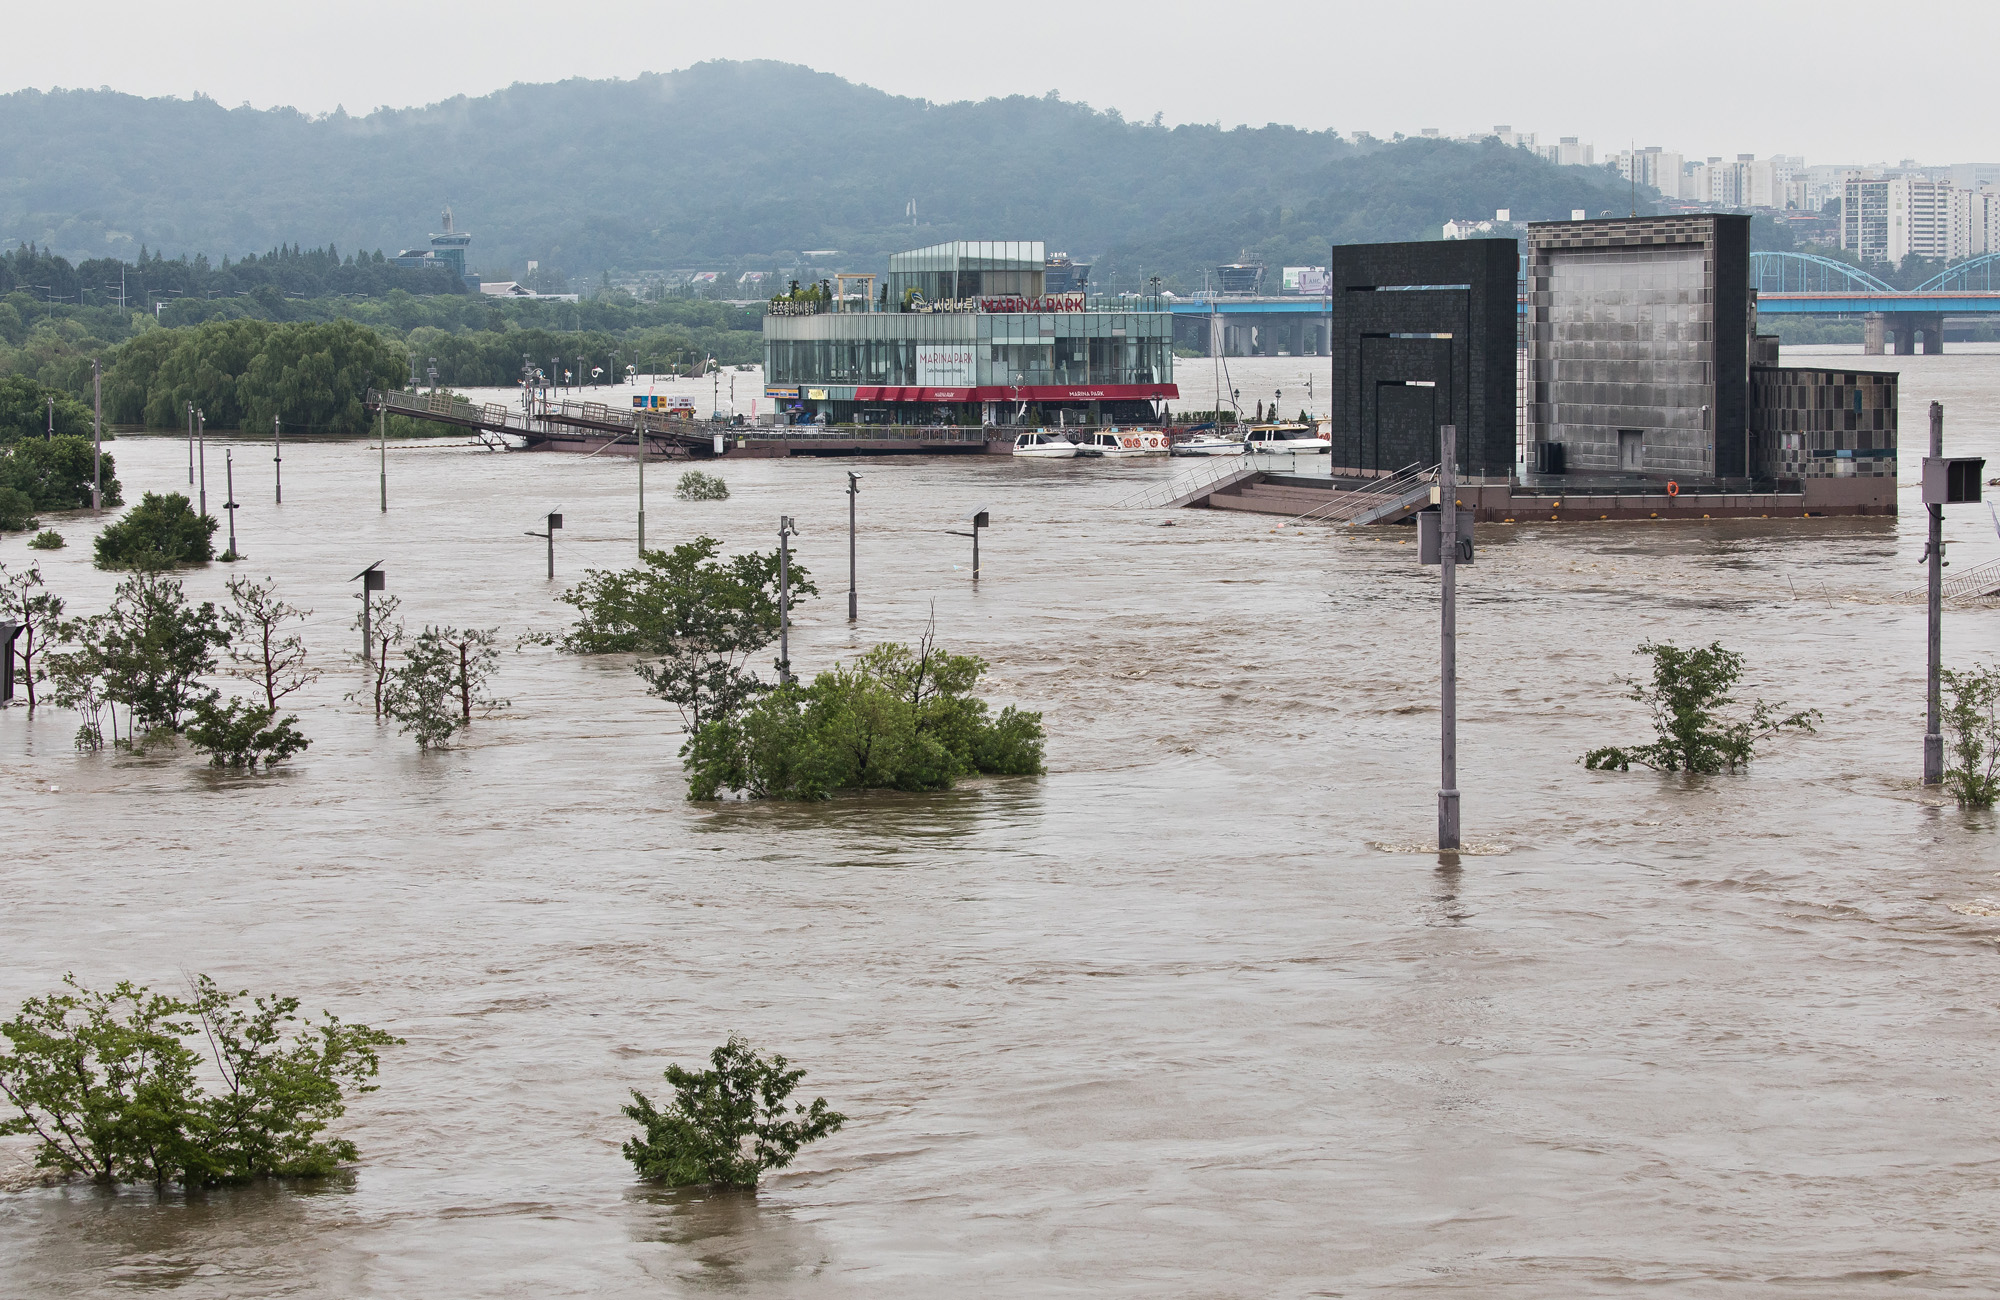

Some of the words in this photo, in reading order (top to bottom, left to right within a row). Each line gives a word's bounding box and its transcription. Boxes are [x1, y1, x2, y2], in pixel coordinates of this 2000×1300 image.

[935, 297, 973, 313] 서래나루
[981, 298, 1042, 312] MARINA
[1046, 298, 1083, 312] PARK
[920, 353, 953, 364] MARINA
[954, 353, 973, 364] PARK
